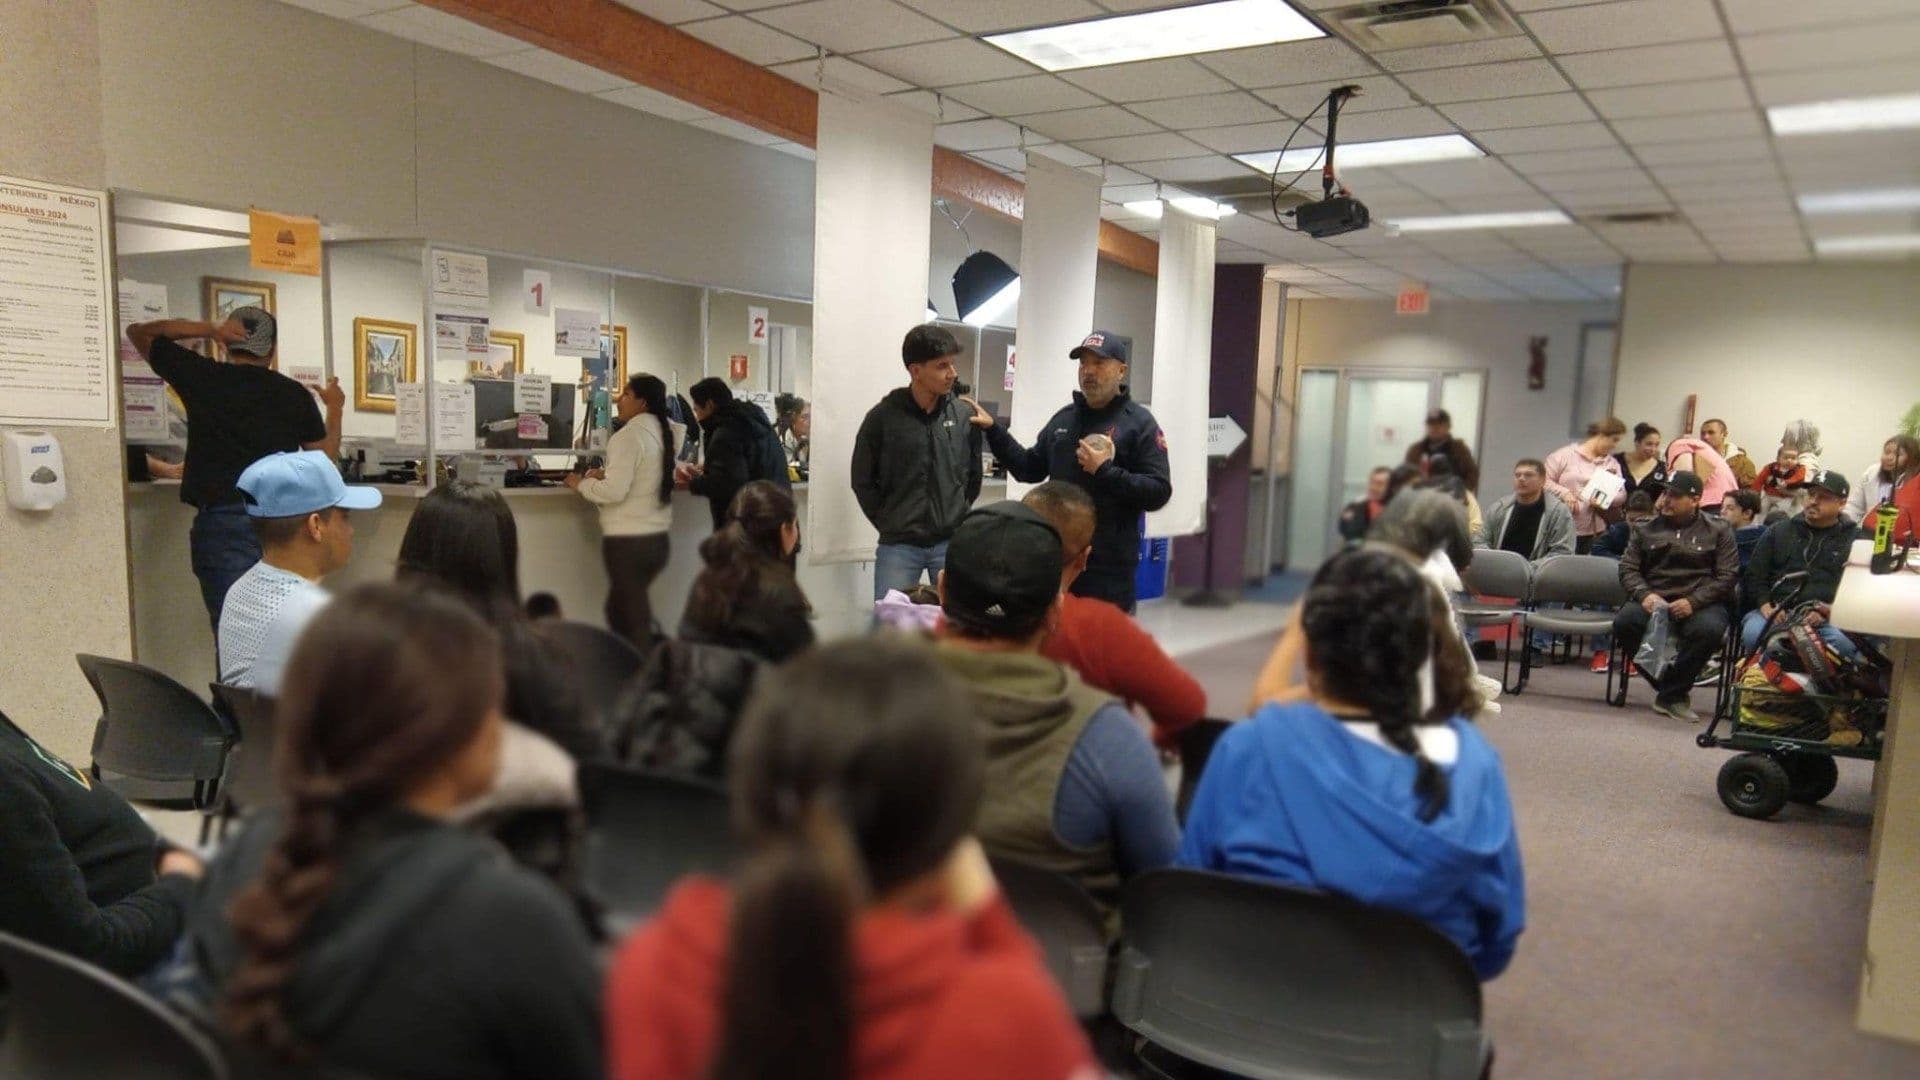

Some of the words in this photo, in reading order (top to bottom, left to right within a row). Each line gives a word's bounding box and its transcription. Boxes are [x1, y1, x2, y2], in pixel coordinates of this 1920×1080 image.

[59, 195, 96, 208] MÉXICO
[47, 210, 67, 220] 2024
[530, 282, 543, 307] 1
[1399, 293, 1425, 312] EXIT
[753, 317, 765, 339] 2
[1008, 352, 1016, 368] 4
